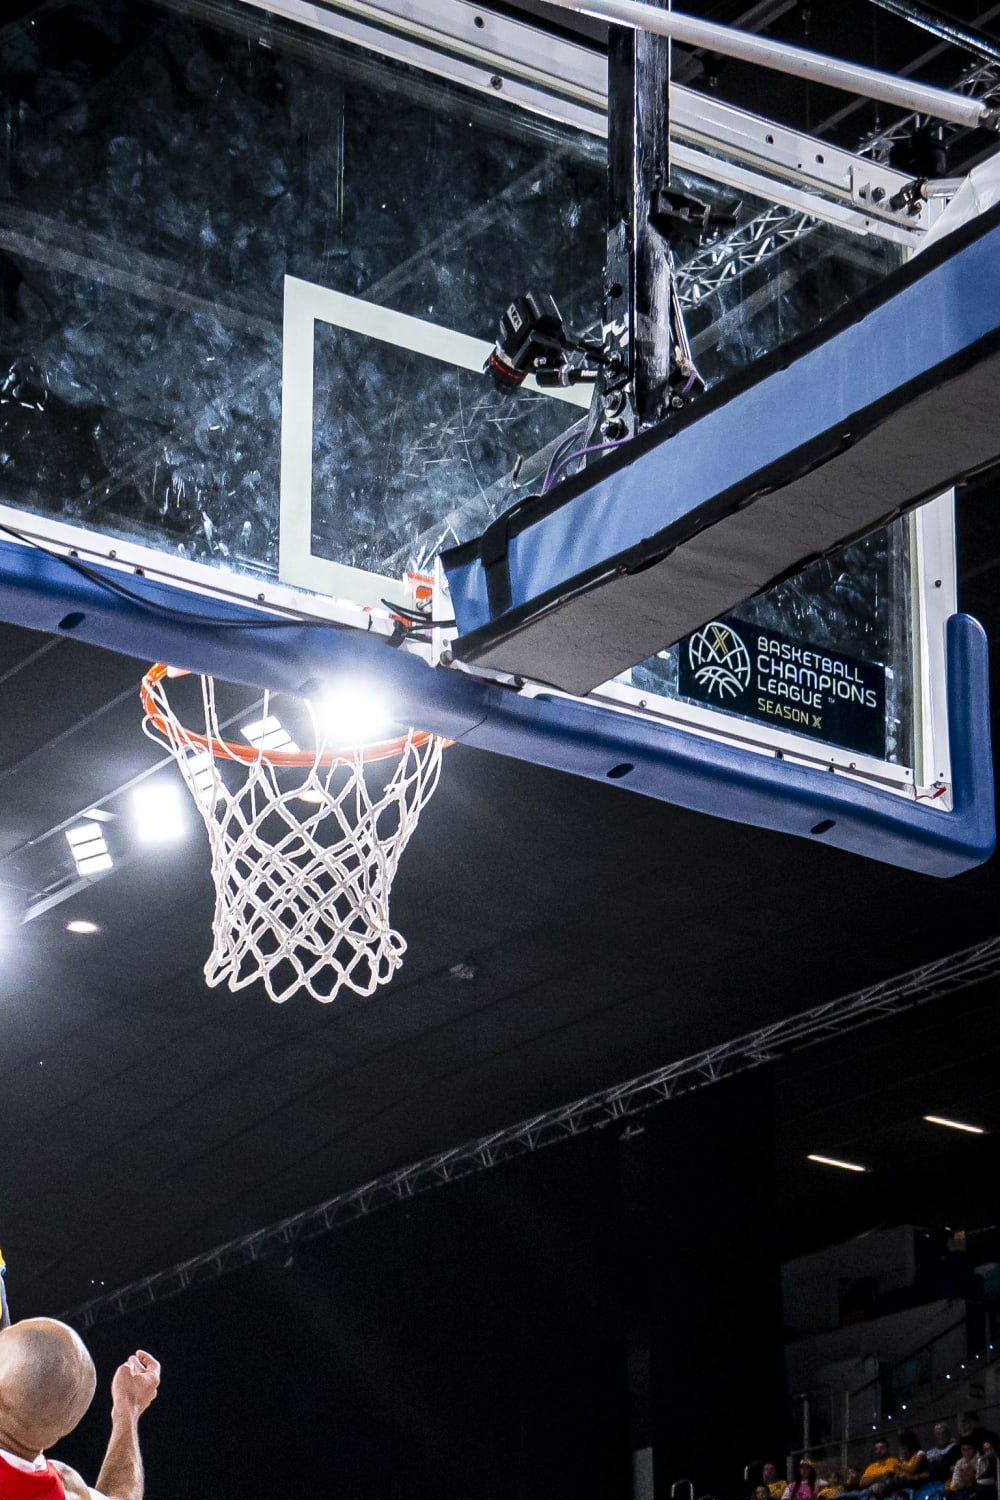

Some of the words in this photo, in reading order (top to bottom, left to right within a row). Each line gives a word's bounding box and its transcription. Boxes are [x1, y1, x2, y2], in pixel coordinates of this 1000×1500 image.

[757, 636, 864, 684] BASKETBALL
[757, 654, 877, 708] CHAMPIONS
[757, 675, 823, 709] LEAGUE
[757, 697, 809, 726] SEASON
[811, 714, 823, 730] X
